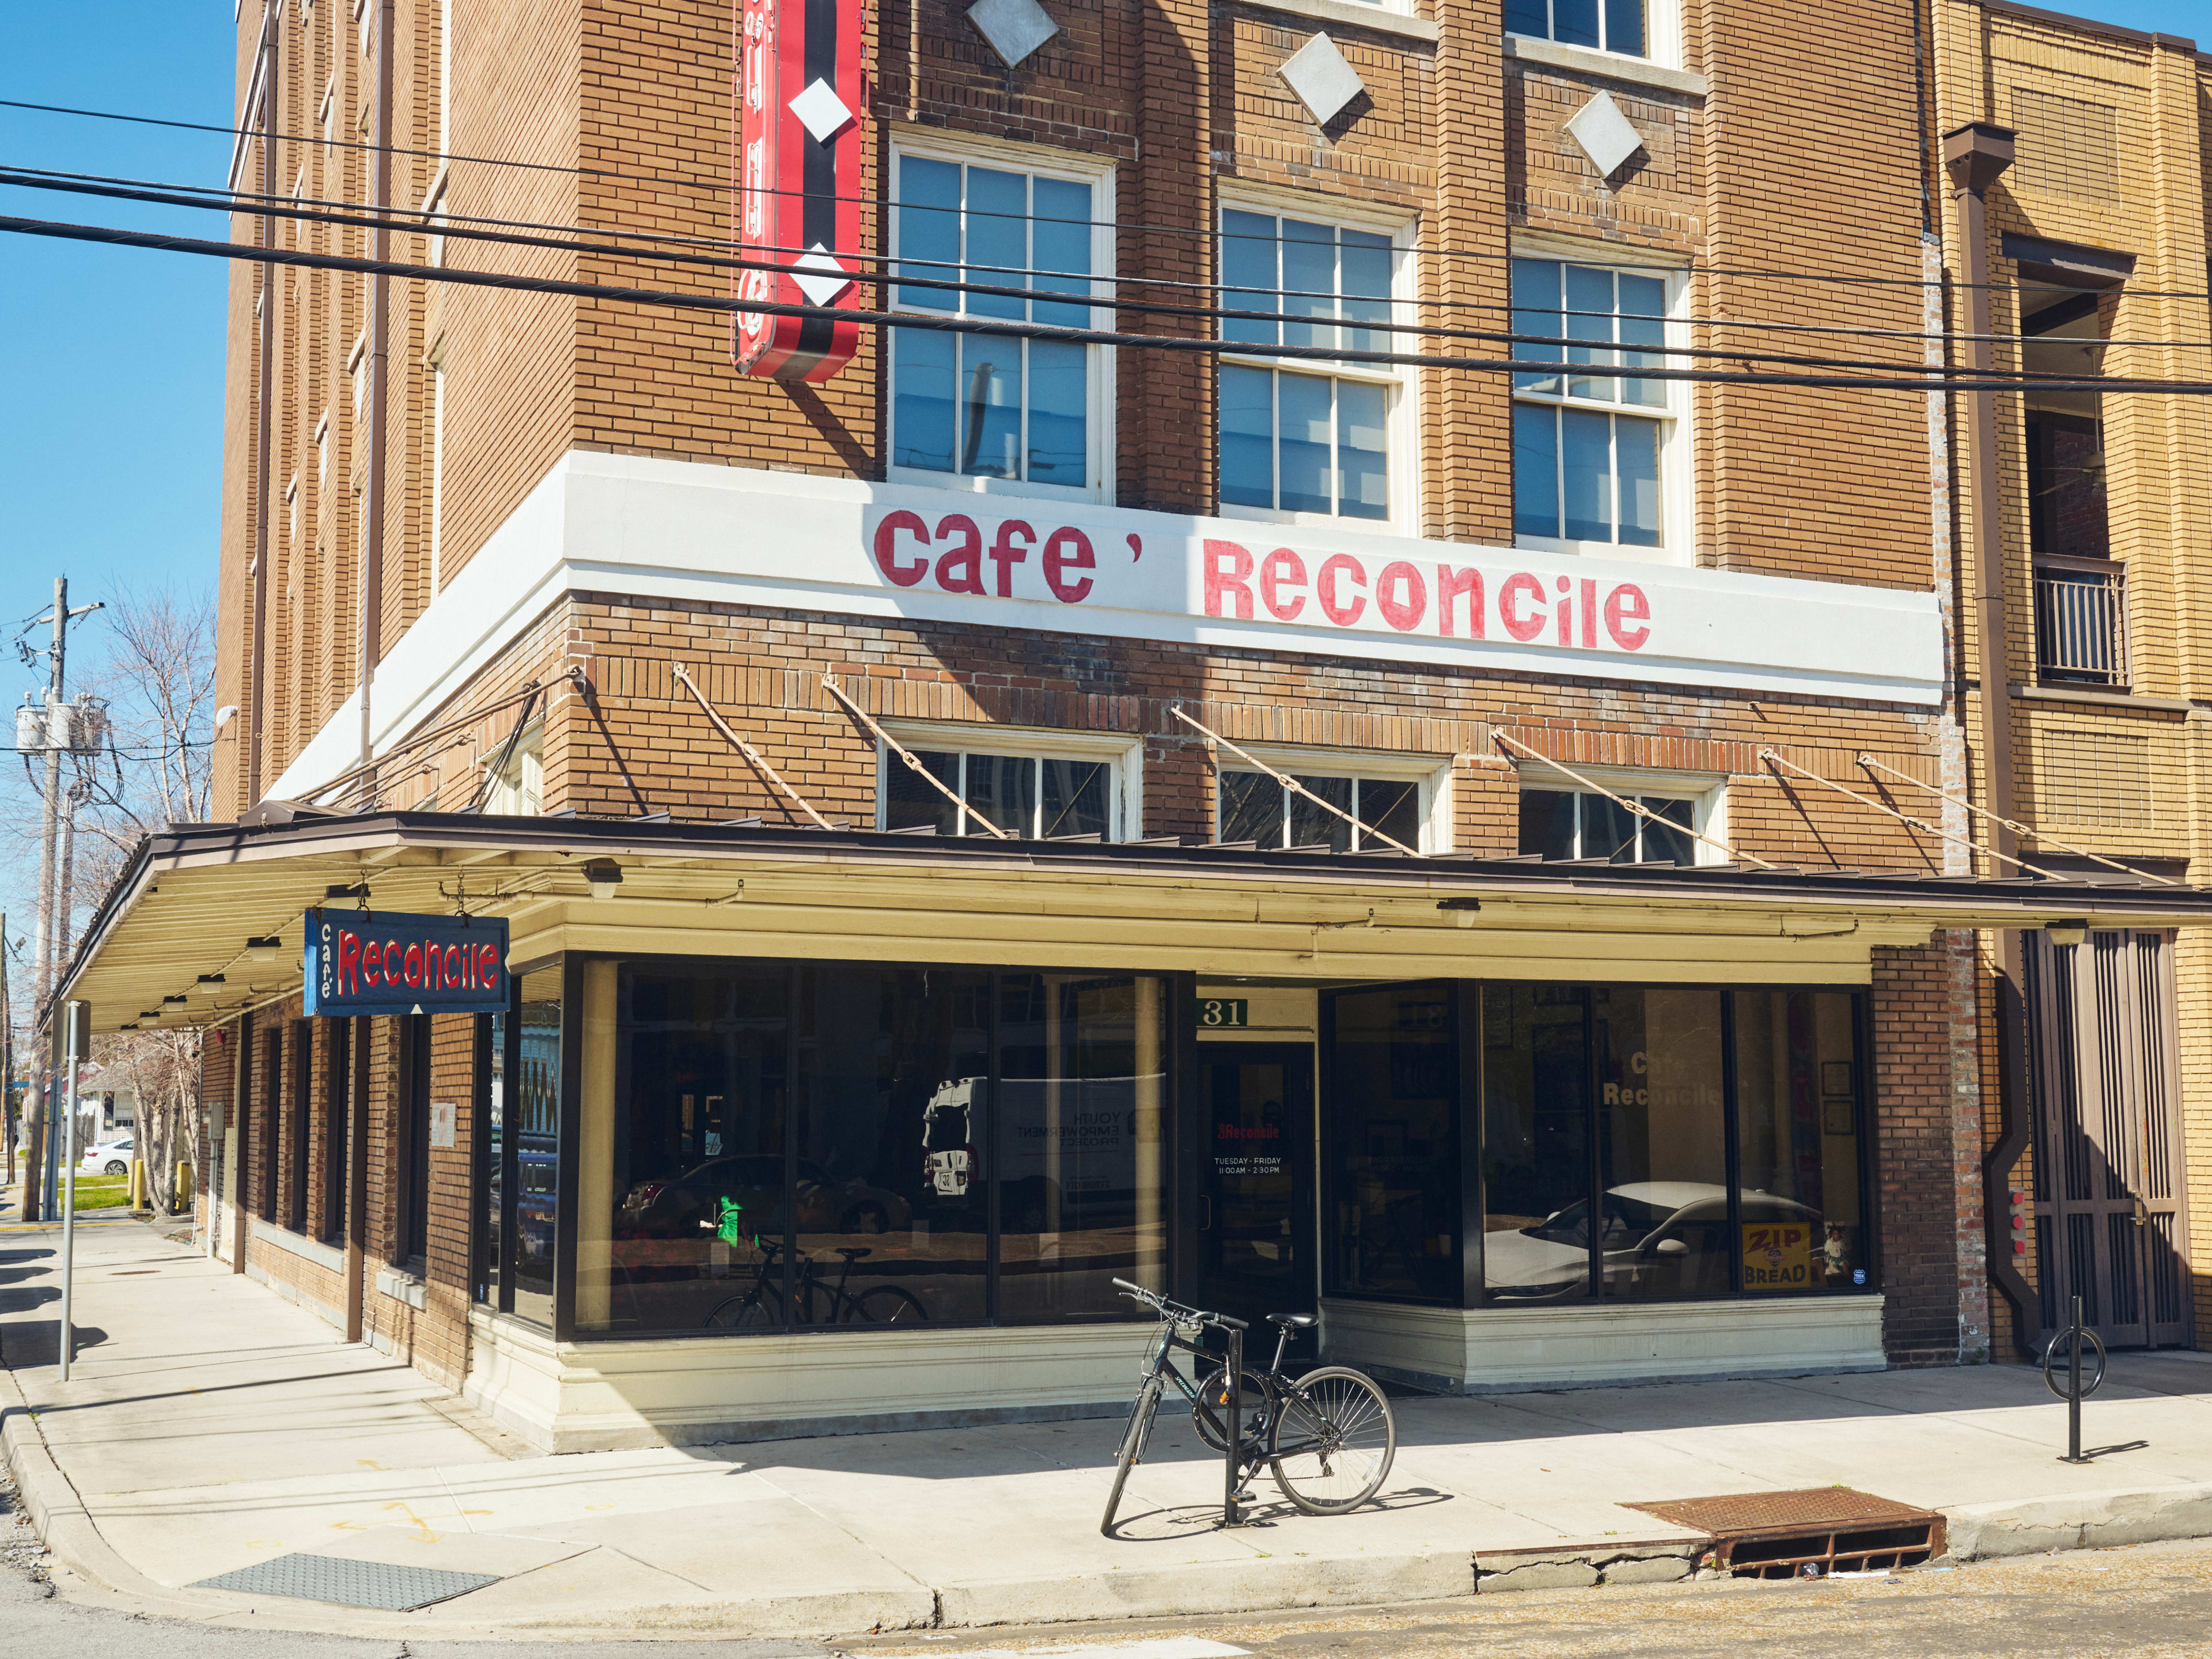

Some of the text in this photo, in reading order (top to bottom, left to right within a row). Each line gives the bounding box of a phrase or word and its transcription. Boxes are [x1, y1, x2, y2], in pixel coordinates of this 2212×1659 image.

[1203, 538, 1652, 651] Reconcile
[338, 929, 498, 997] Reconcile
[1203, 1000, 1240, 1026] 31
[1226, 1123, 1279, 1139] Reconcile
[1745, 1229, 1801, 1253] ZIP
[1745, 1264, 1805, 1284] BREAD
